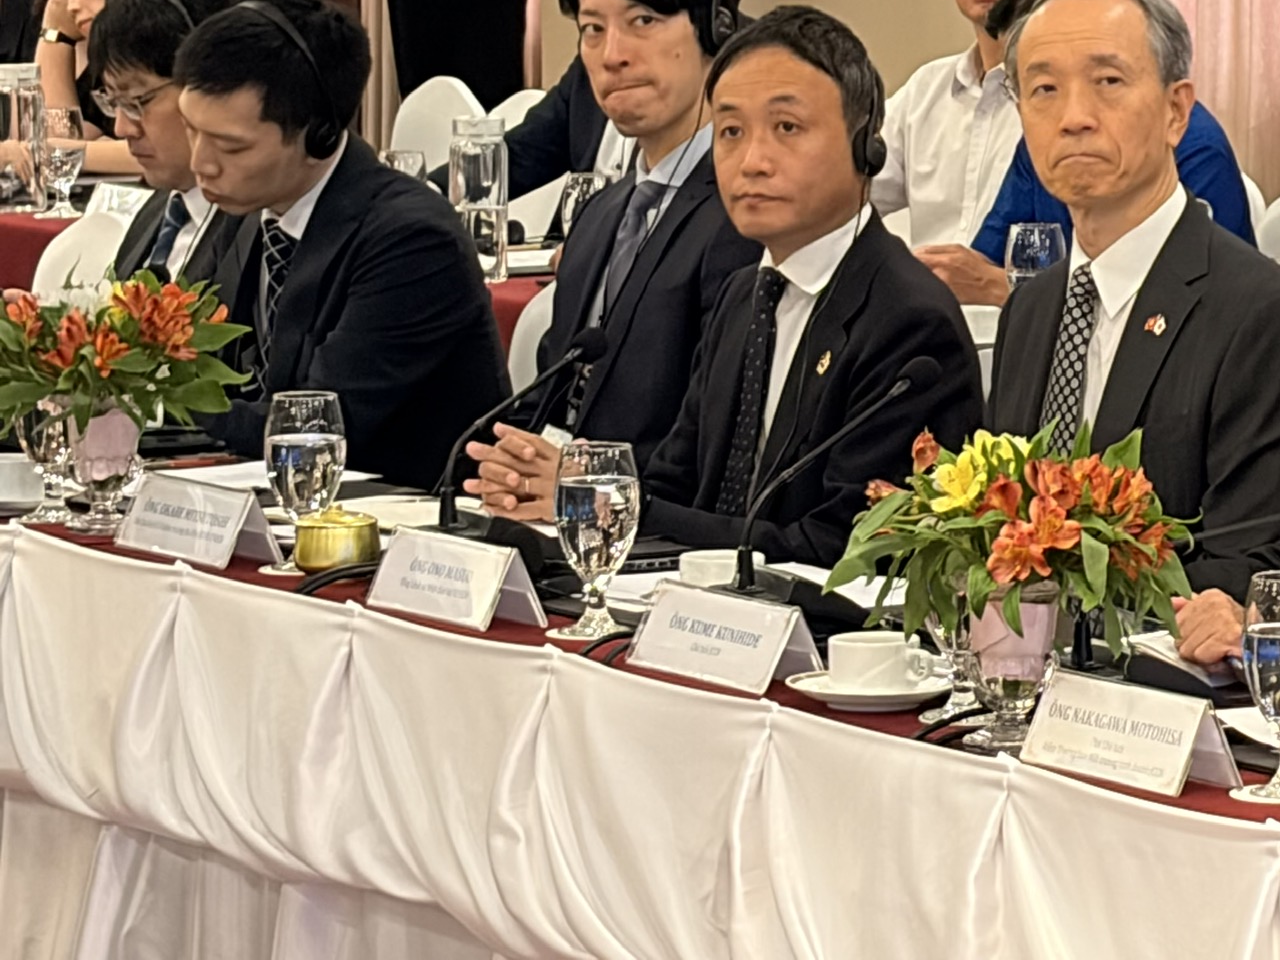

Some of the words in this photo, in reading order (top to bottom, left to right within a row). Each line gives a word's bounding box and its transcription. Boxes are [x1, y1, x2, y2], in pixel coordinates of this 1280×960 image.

[669, 611, 690, 631] ÔNG
[1048, 698, 1072, 721] ÔNG
[1071, 707, 1129, 736] NAKAGAWA
[1128, 720, 1184, 748] MOTOHISA
